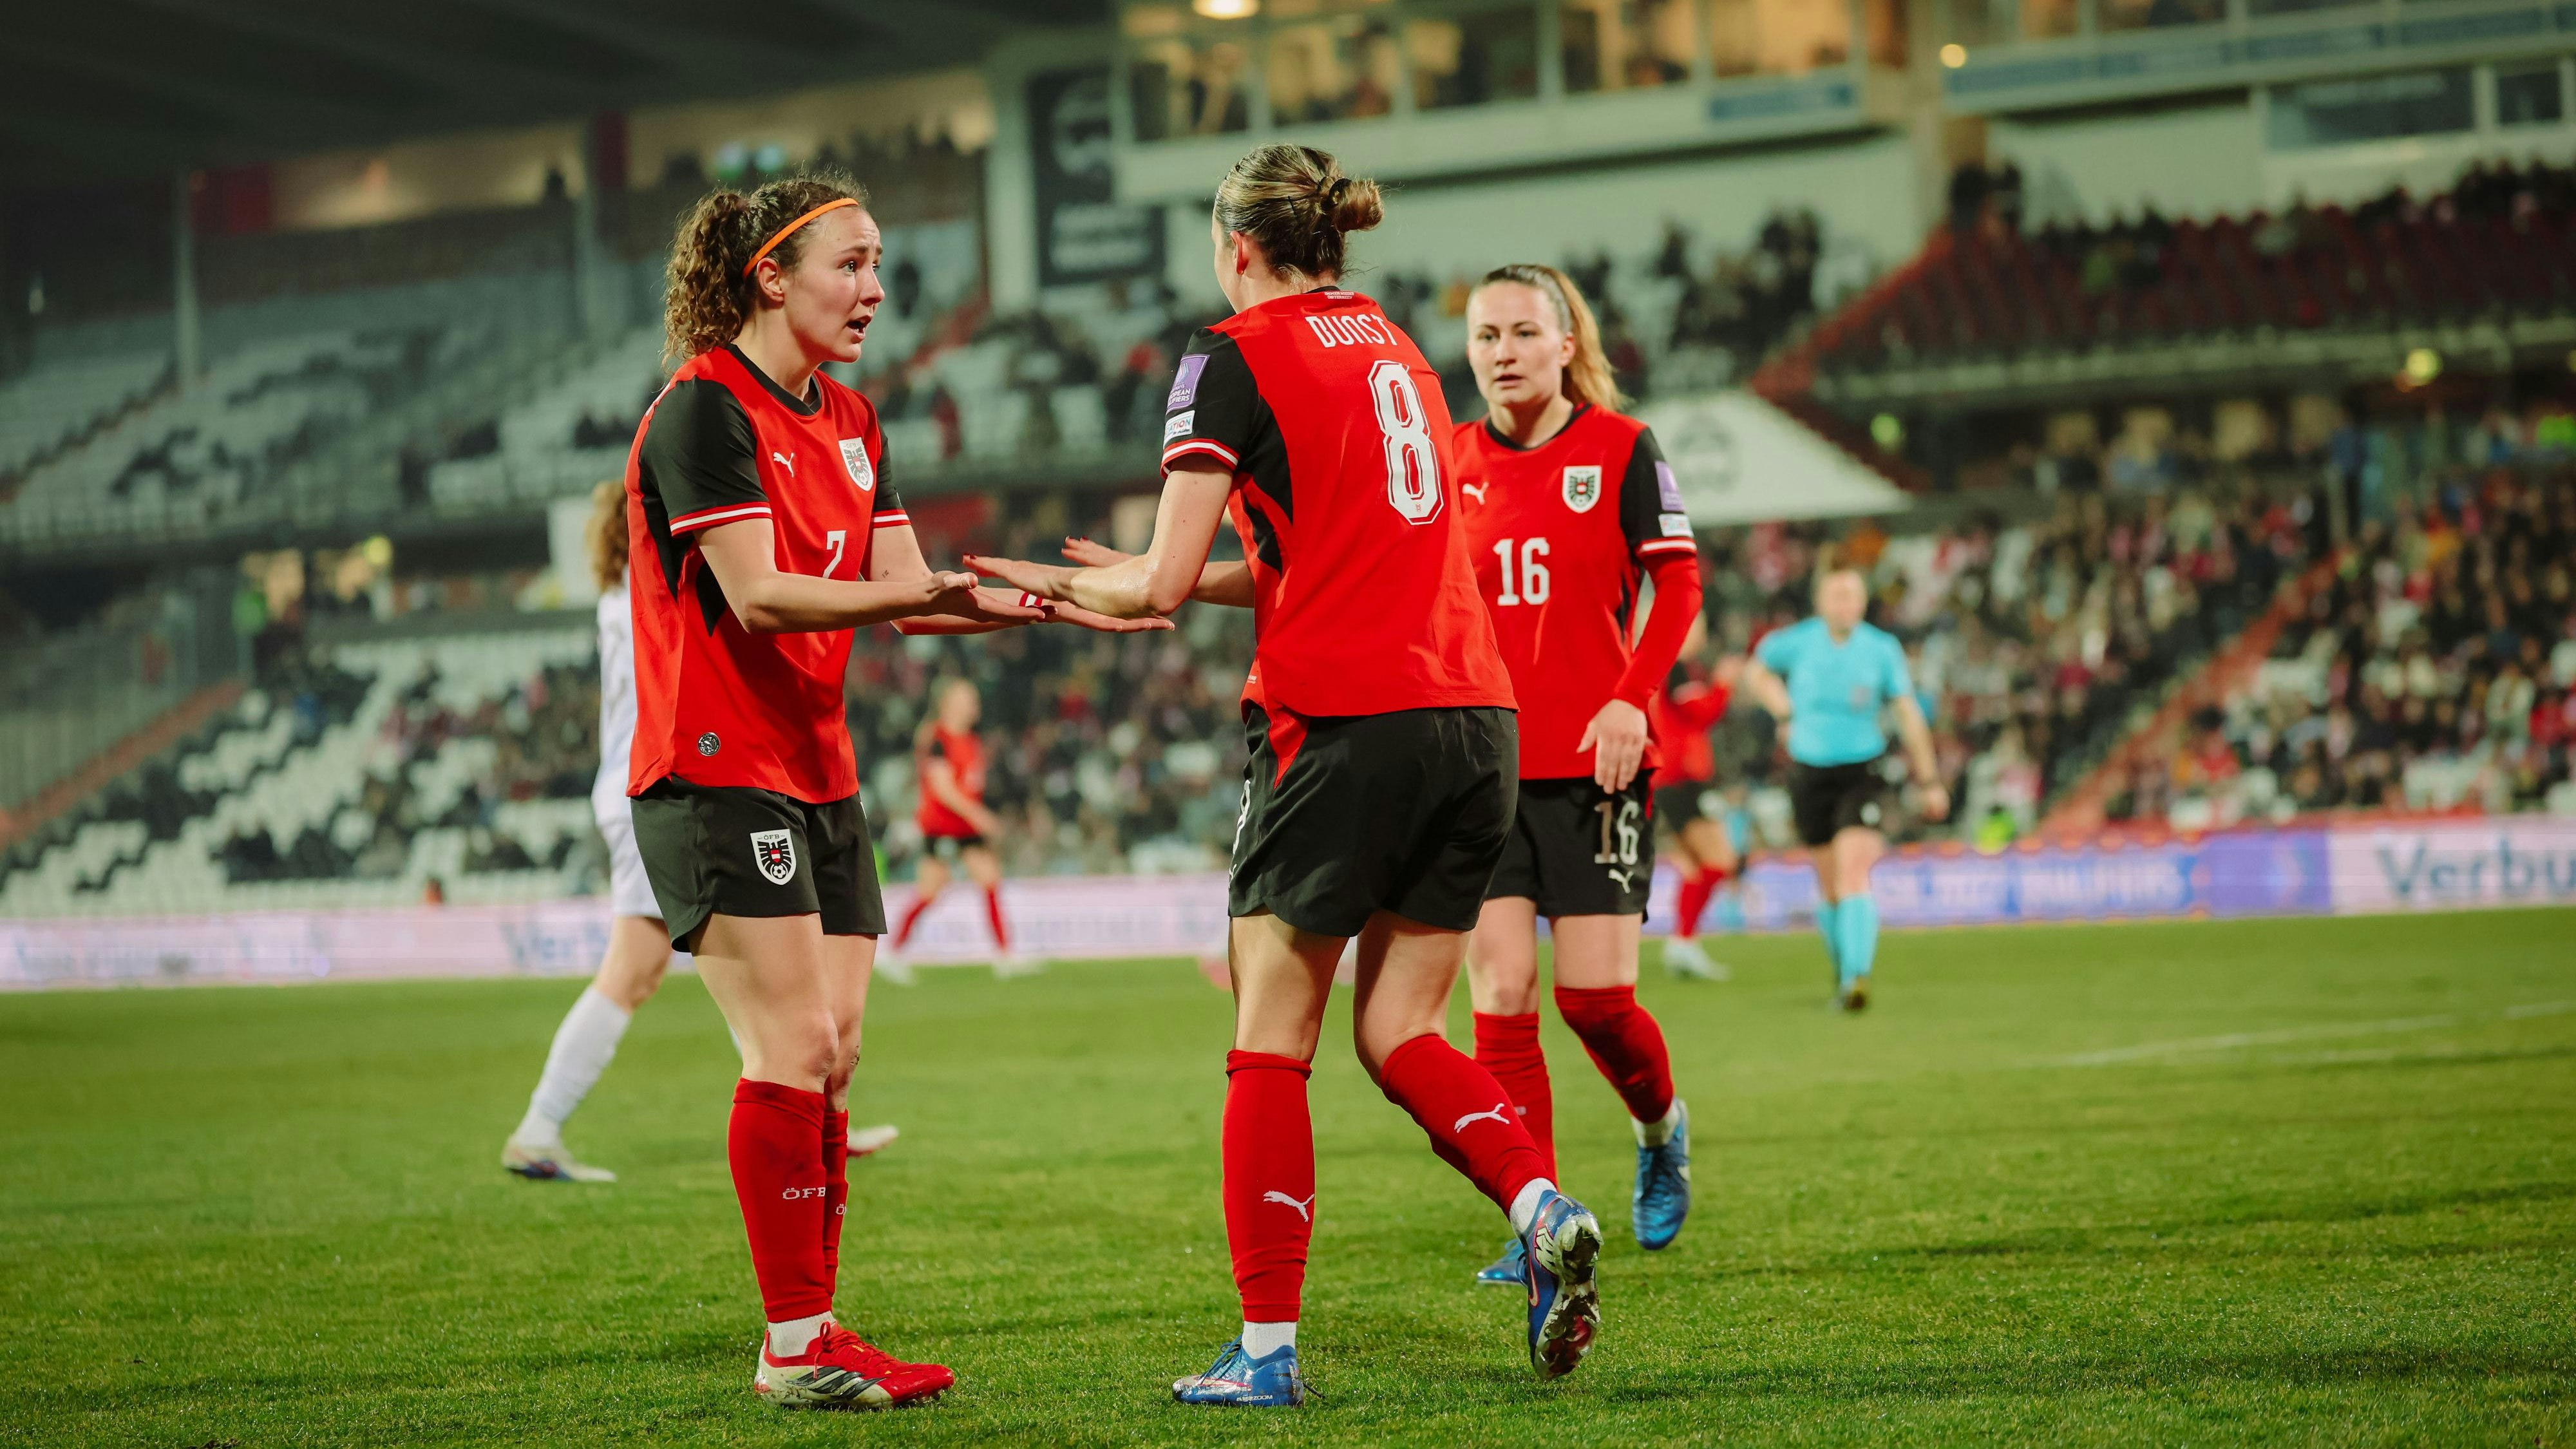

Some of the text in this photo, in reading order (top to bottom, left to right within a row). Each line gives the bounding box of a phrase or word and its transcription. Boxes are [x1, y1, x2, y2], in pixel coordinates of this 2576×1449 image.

[1305, 314, 1397, 348] DUNST
[1367, 359, 1444, 526] 8
[822, 530, 846, 579] 7
[1493, 536, 1549, 606] 16
[1594, 800, 1640, 865] 16
[782, 1187, 826, 1199] ÖFB
